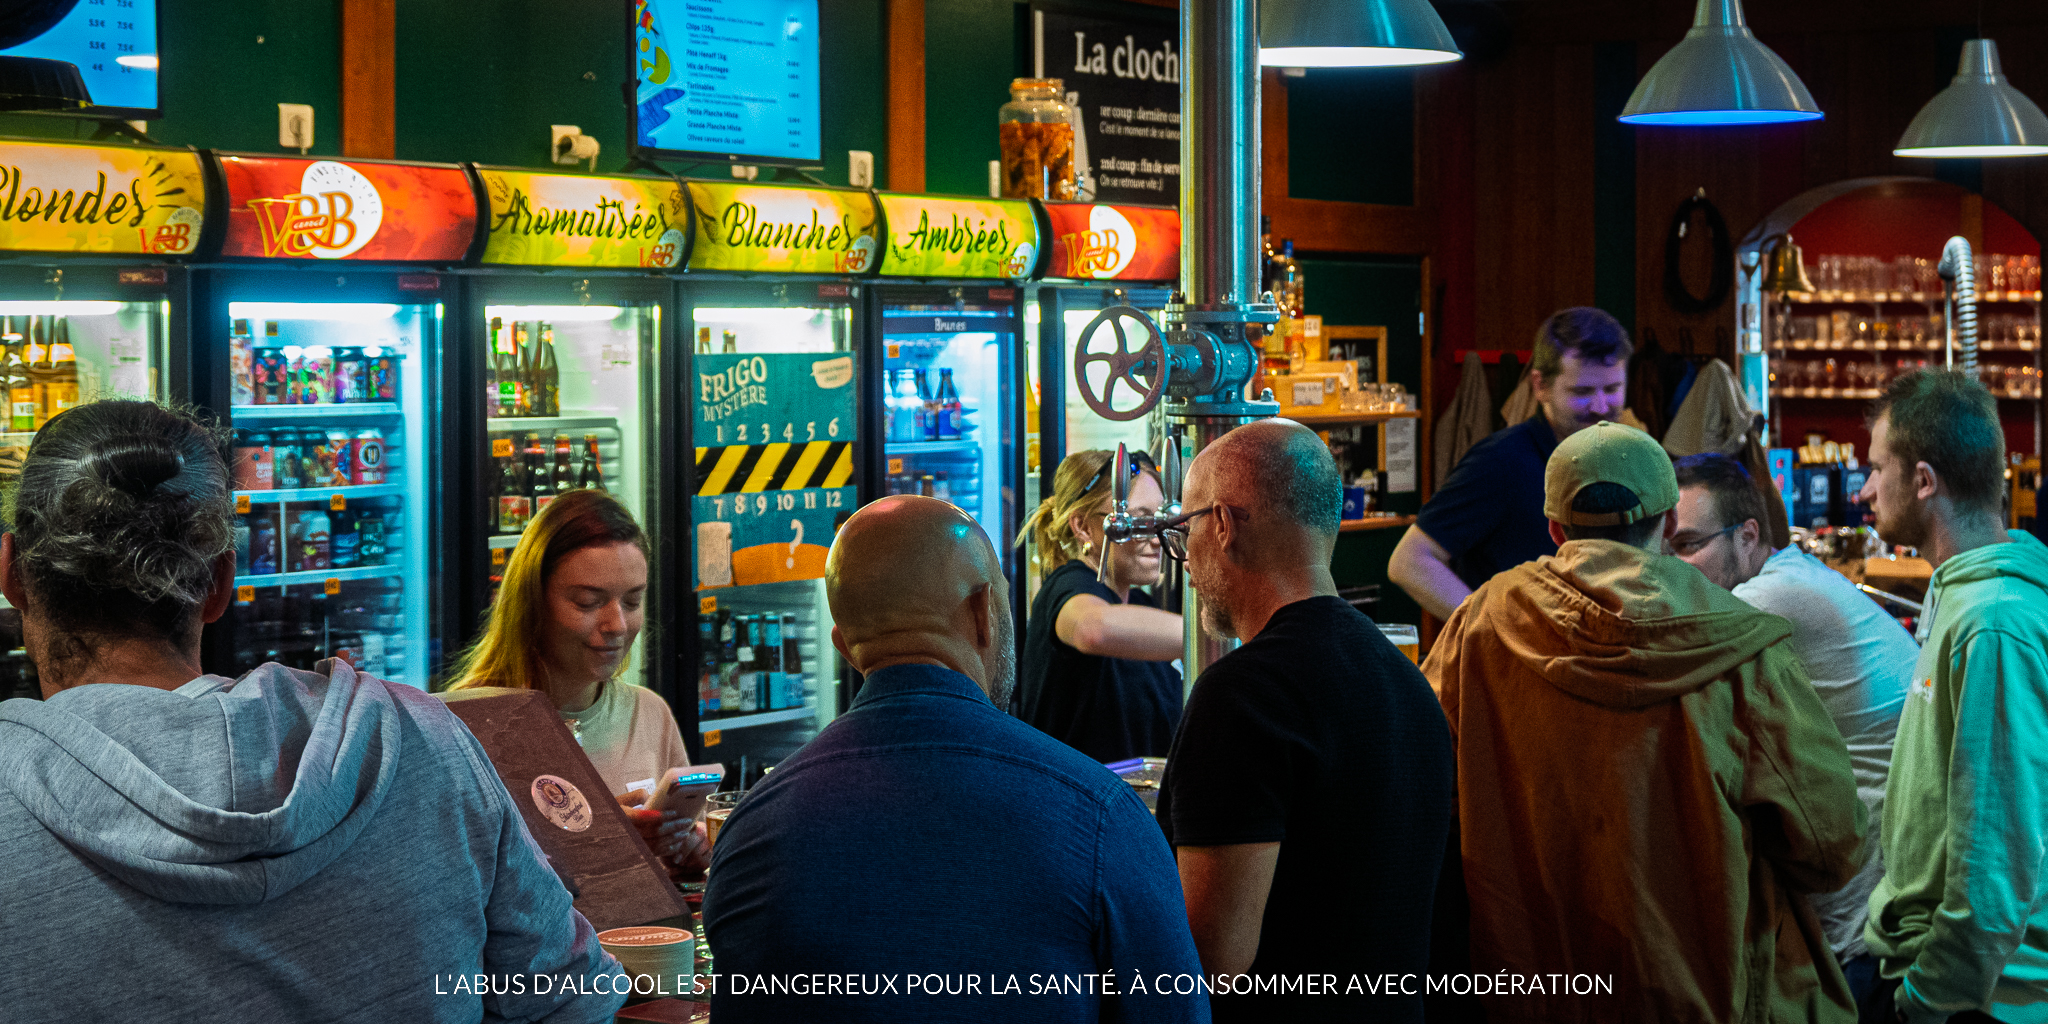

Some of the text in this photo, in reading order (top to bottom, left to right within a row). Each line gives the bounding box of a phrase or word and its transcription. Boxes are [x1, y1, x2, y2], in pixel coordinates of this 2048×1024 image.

[686, 22, 700, 32] Chips
[1075, 31, 1108, 75] La
[0, 165, 152, 227] londes
[490, 187, 673, 241] Aromatisées
[722, 201, 855, 252] Blanches
[904, 209, 1018, 255] Ambrées
[934, 317, 967, 332] Brunes
[699, 356, 768, 404] FRIGO
[703, 383, 768, 423] MYSTÈRE
[716, 417, 840, 443] 1 2 3 4 5 6
[713, 491, 842, 520] 7 8 9 10 11 12
